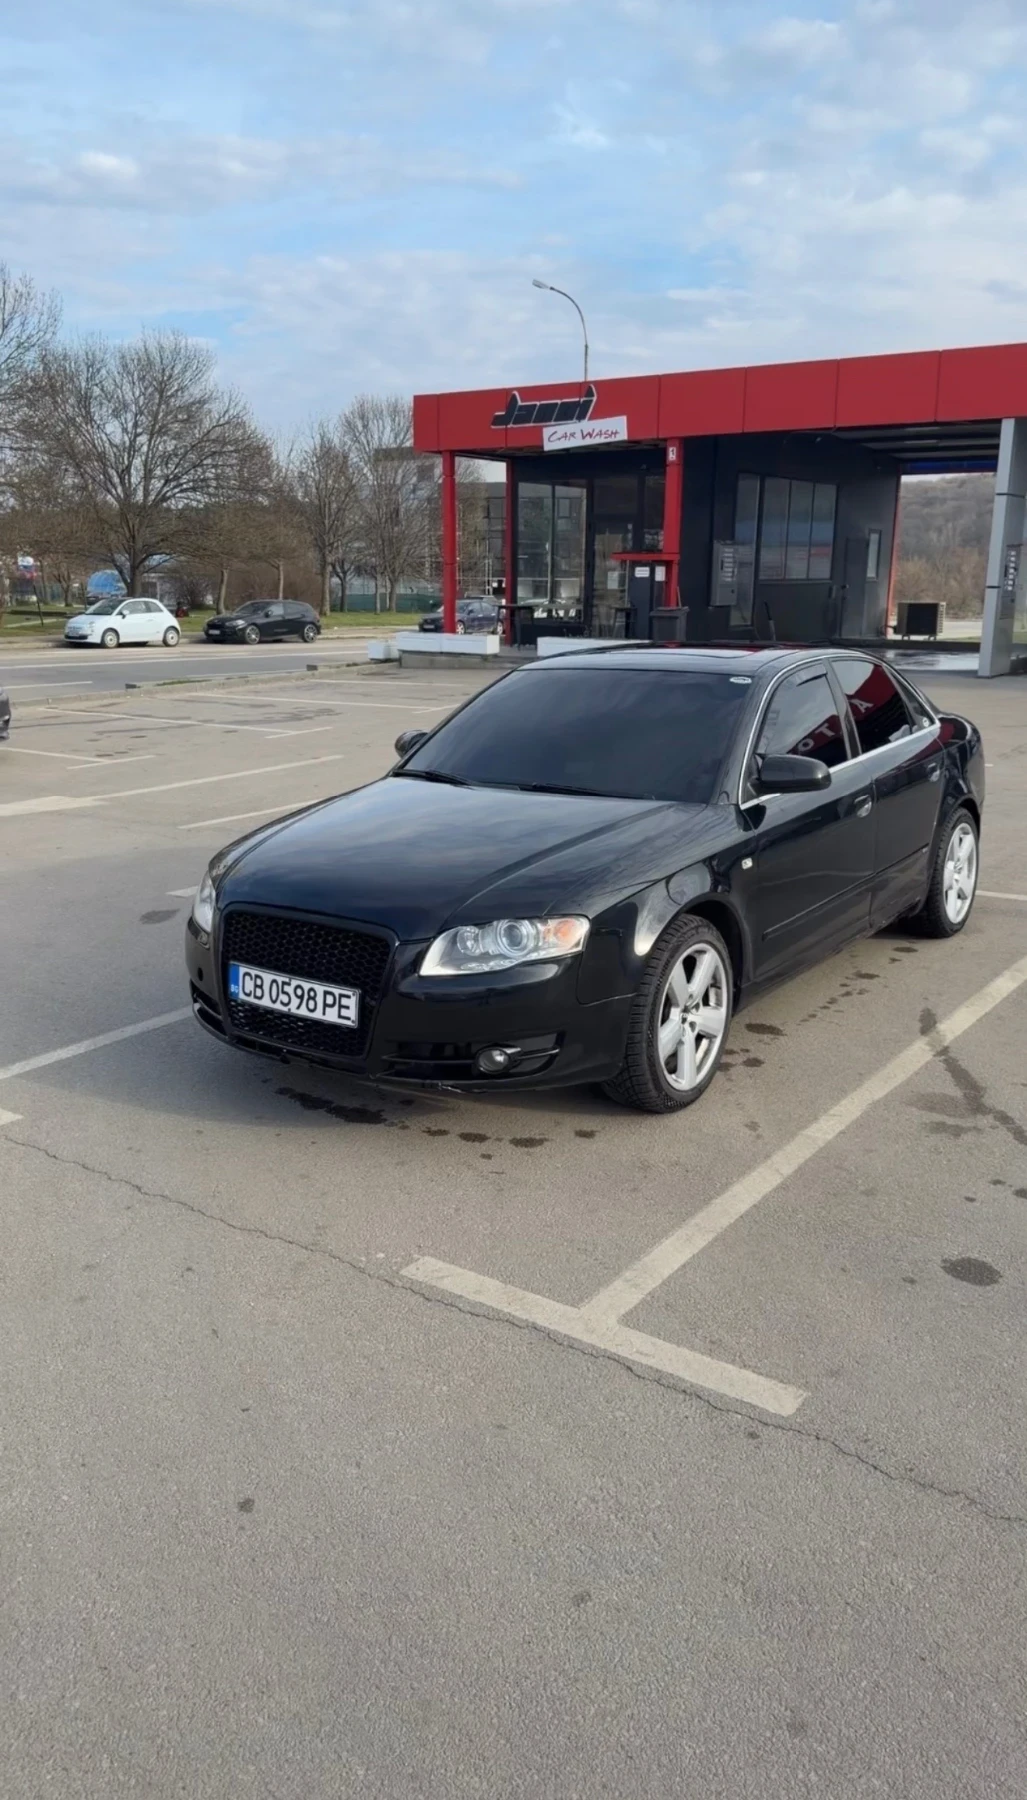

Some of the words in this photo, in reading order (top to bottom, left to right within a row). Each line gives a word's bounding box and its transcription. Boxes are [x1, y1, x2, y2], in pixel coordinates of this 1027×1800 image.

[547, 430, 577, 443] CAR
[580, 428, 620, 440] WASH
[241, 971, 264, 1001] CB
[269, 978, 318, 1014] 0598
[322, 989, 352, 1021] PE
